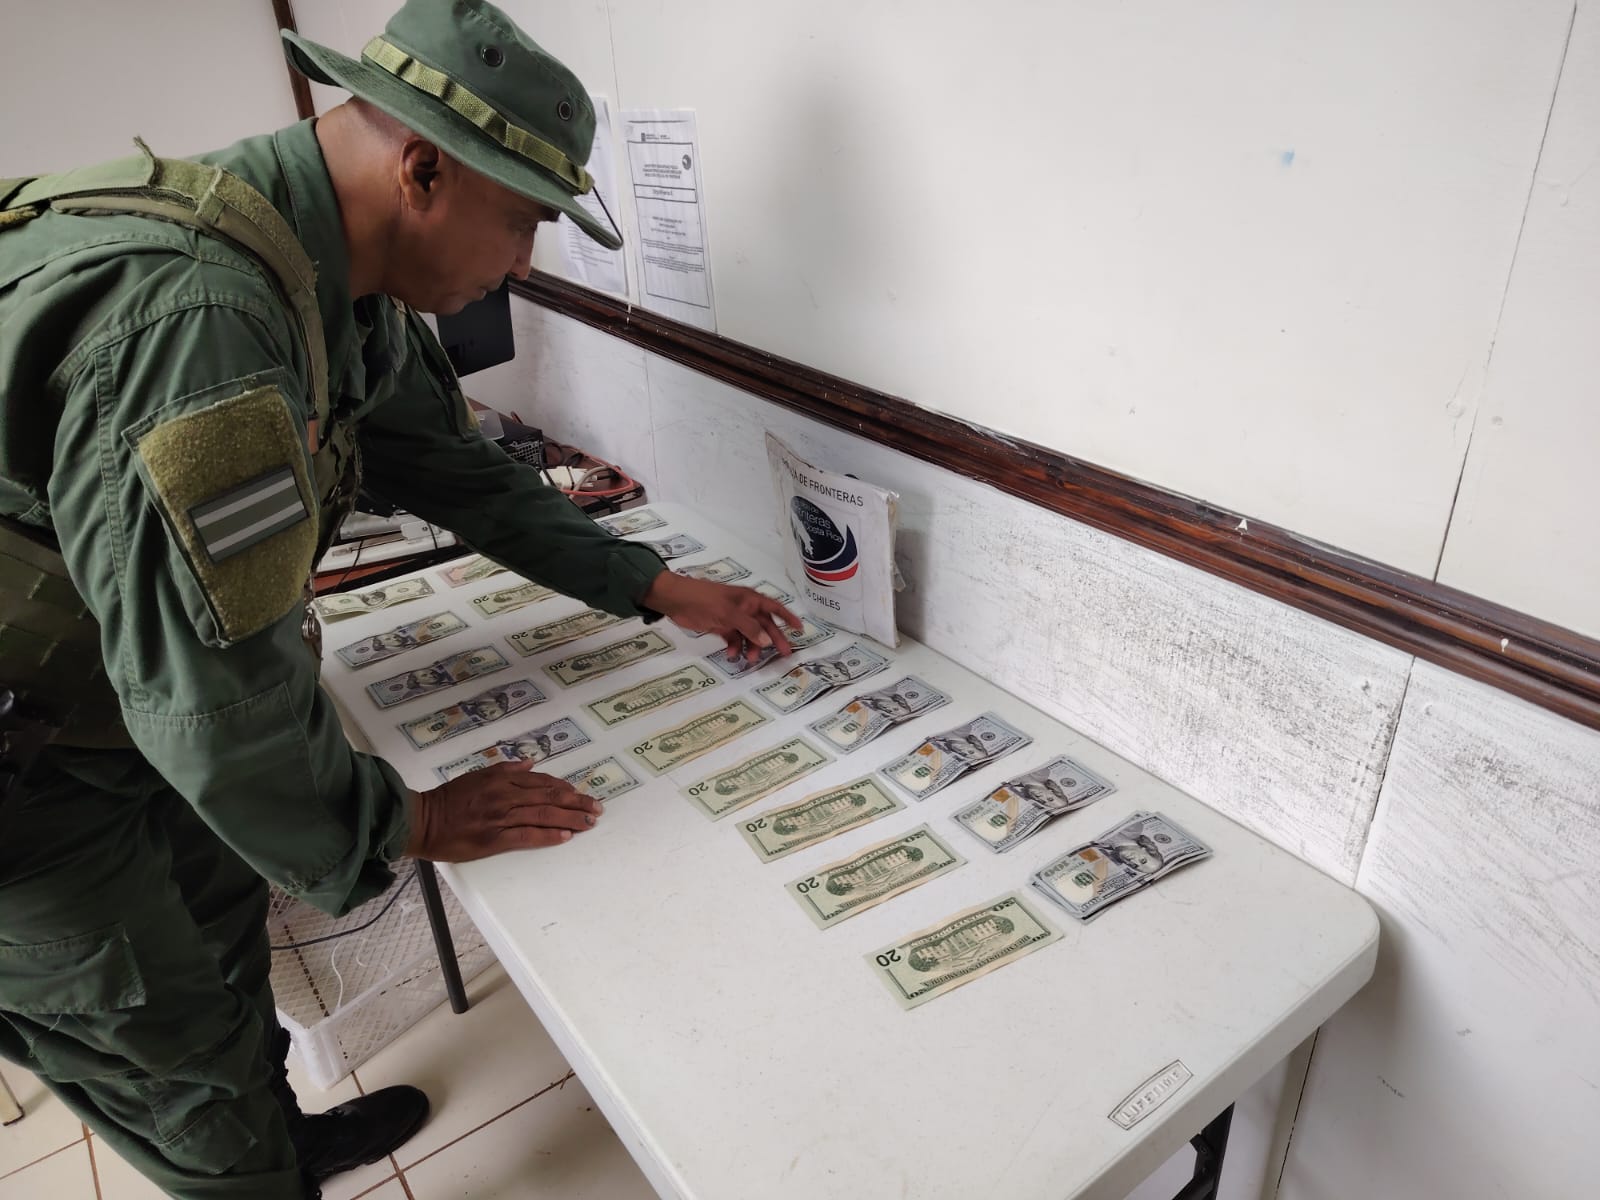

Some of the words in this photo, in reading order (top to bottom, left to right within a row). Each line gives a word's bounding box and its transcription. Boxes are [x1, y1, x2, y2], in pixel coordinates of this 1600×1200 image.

[800, 473, 808, 487] DE
[809, 479, 864, 507] FRONTERAS
[473, 595, 489, 605] 20
[812, 592, 841, 611] CHILES
[511, 630, 529, 640] 20
[548, 661, 567, 672] 20
[698, 677, 716, 688] 20
[633, 741, 653, 755] 20
[688, 782, 709, 796] 20
[746, 818, 767, 833] 20
[796, 876, 819, 894] 20
[875, 949, 902, 967] 20
[1120, 1070, 1180, 1120] LIFETIME
